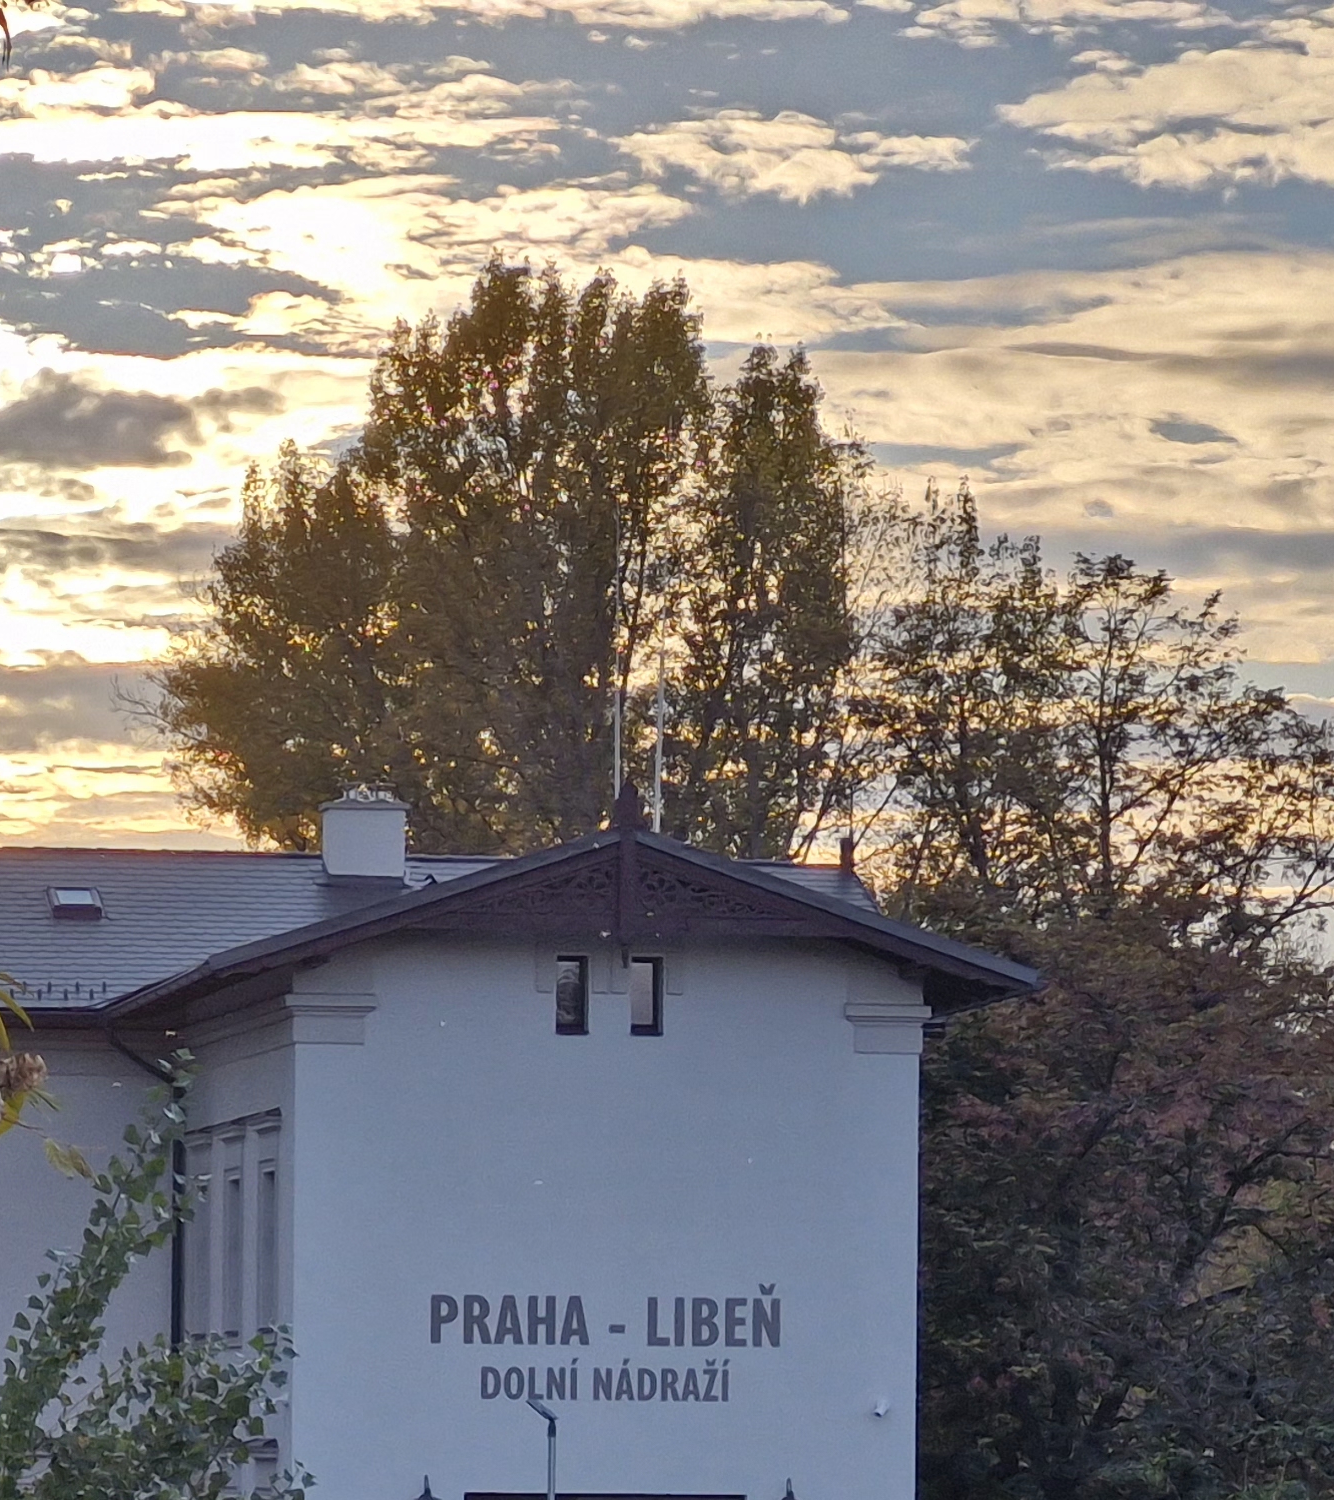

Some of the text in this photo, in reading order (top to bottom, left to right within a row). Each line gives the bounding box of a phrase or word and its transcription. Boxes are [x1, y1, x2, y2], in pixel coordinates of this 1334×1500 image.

[430, 1294, 590, 1346] PRAHA
[647, 1283, 782, 1348] LIBEŇ
[480, 1357, 730, 1402] DOLNÍ NÁDRAŽÍ
